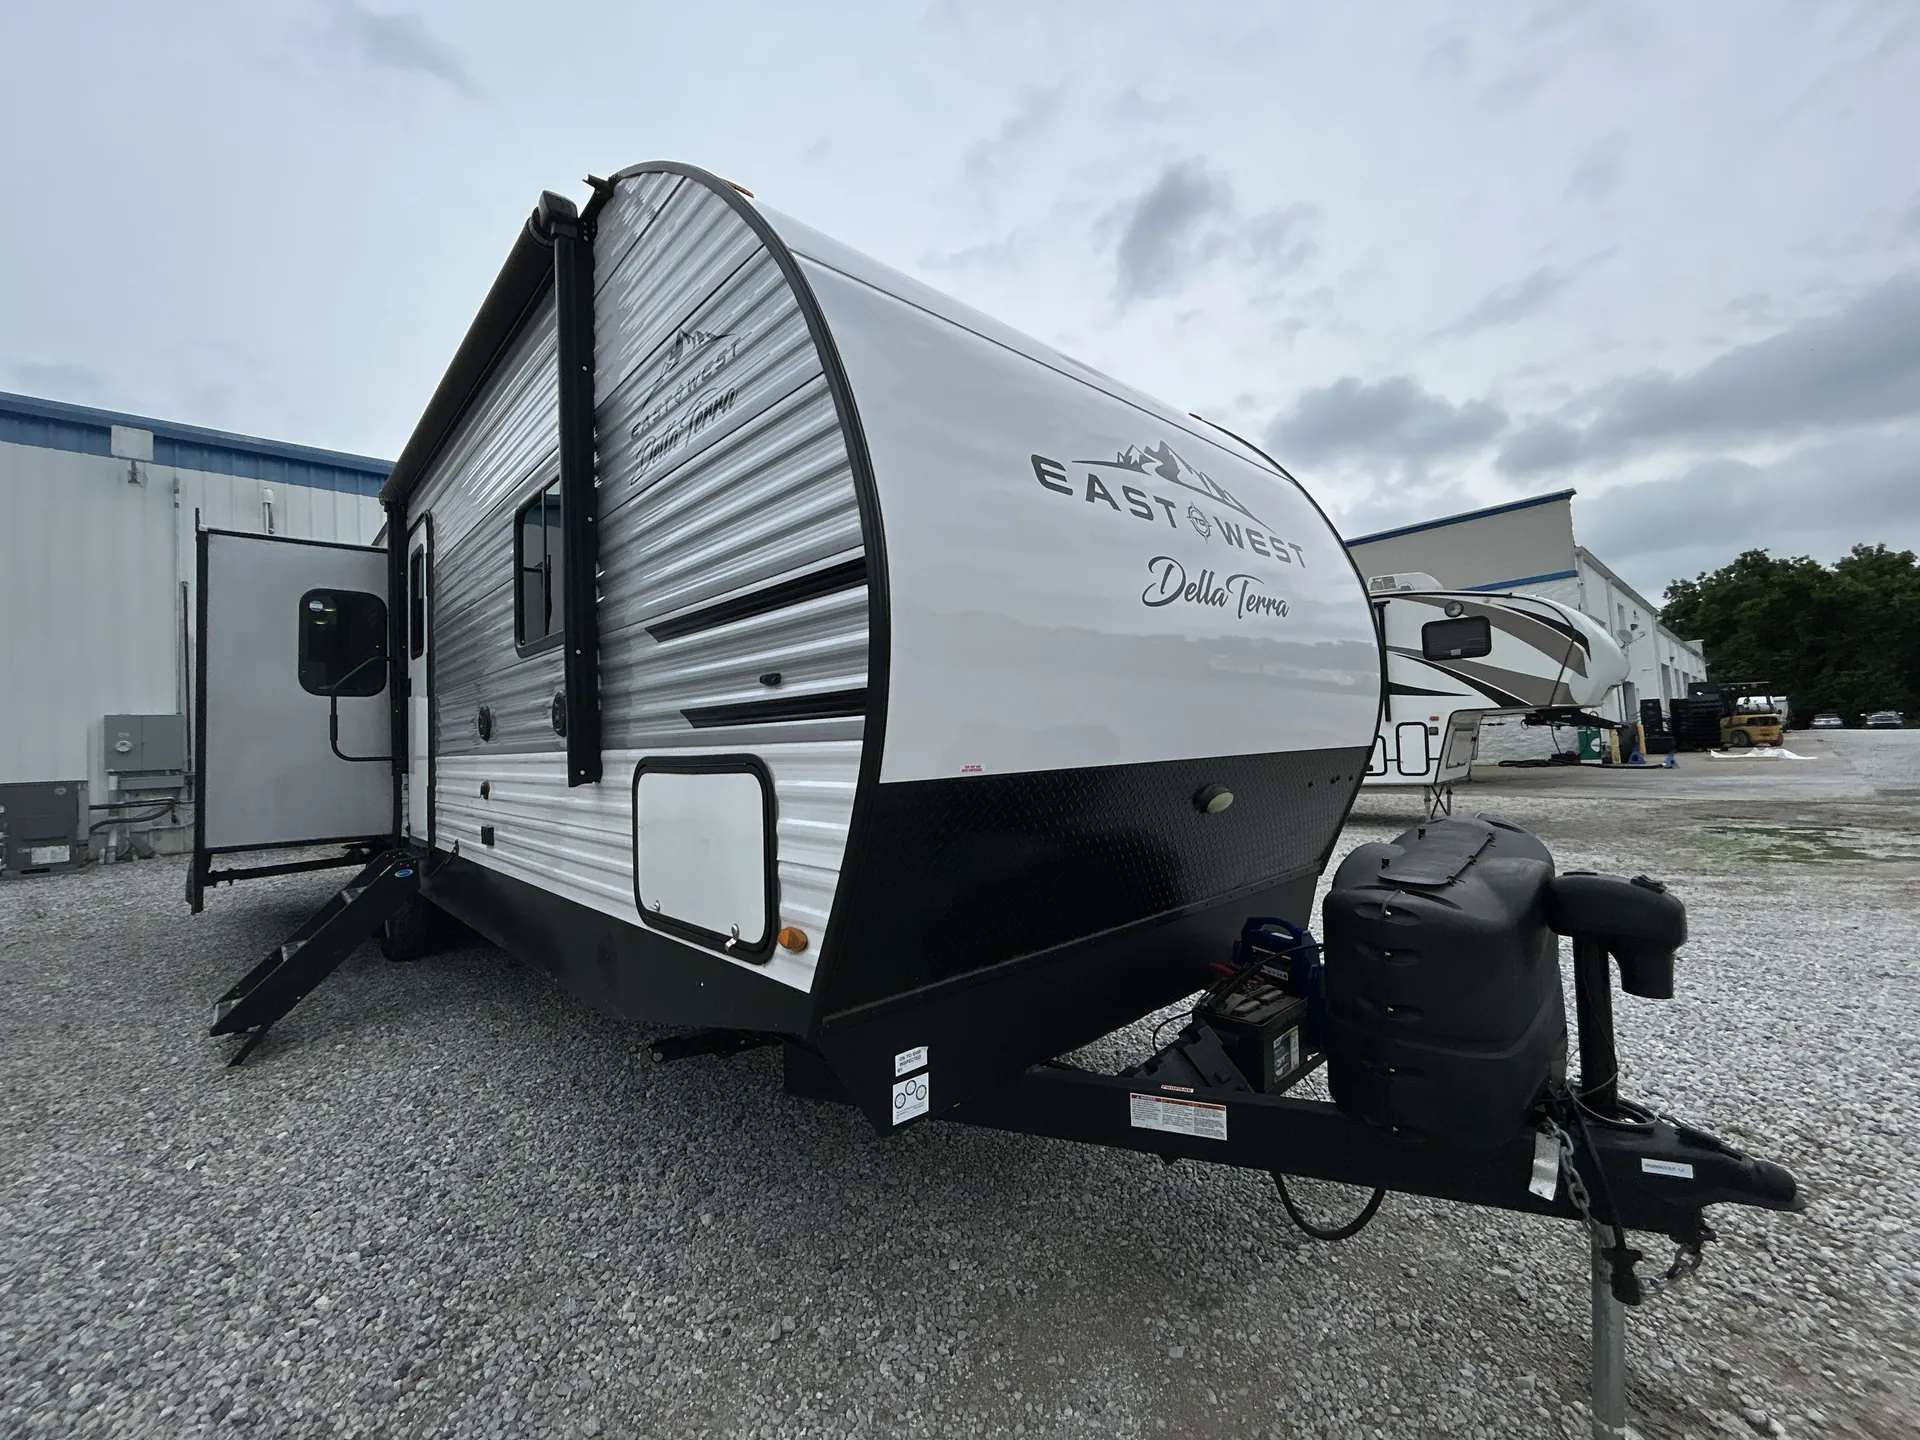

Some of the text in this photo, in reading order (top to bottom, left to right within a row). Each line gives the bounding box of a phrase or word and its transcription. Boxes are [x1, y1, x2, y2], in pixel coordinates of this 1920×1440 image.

[1030, 453, 1178, 529] EAST
[1212, 515, 1307, 569] WEST
[1141, 555, 1290, 619] Della Terra
